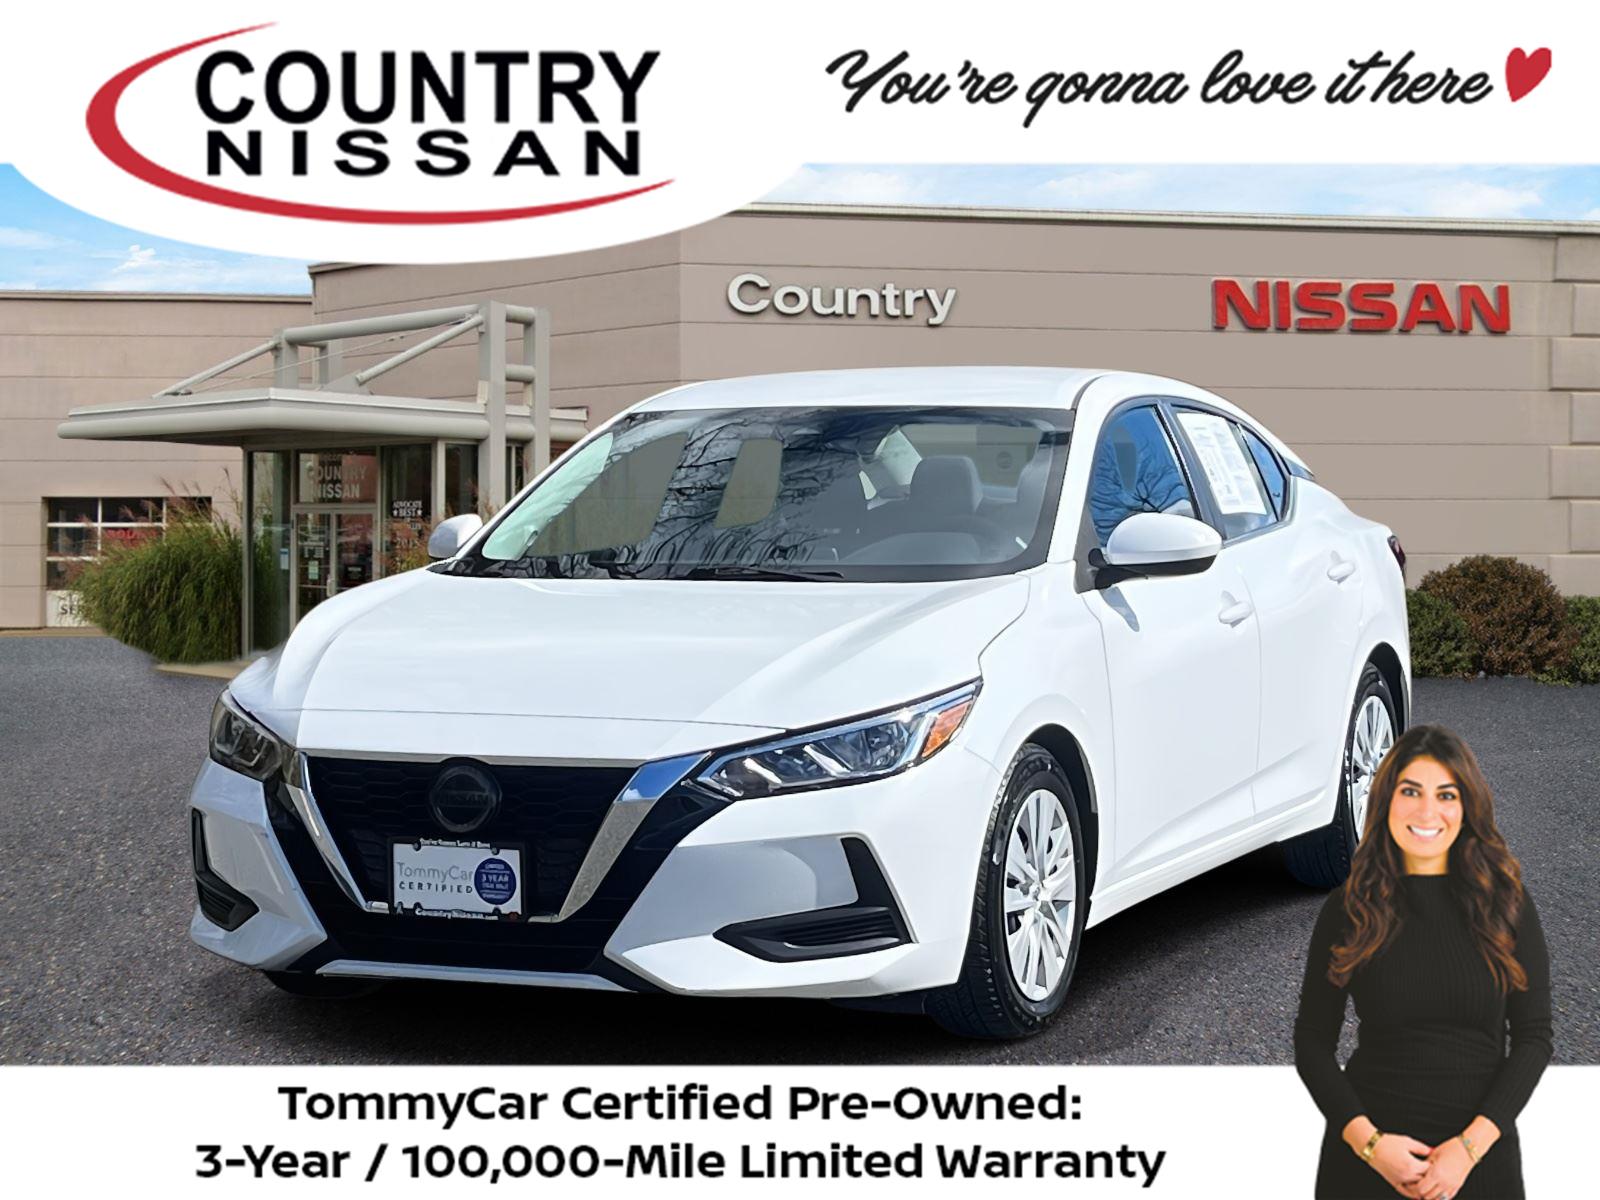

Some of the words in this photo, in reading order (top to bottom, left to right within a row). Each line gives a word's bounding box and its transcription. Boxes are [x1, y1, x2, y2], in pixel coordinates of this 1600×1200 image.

[727, 273, 957, 326] Country
[1213, 277, 1511, 335] NISSAN
[396, 861, 474, 884] TommyCar
[398, 880, 474, 895] CERTIFIED
